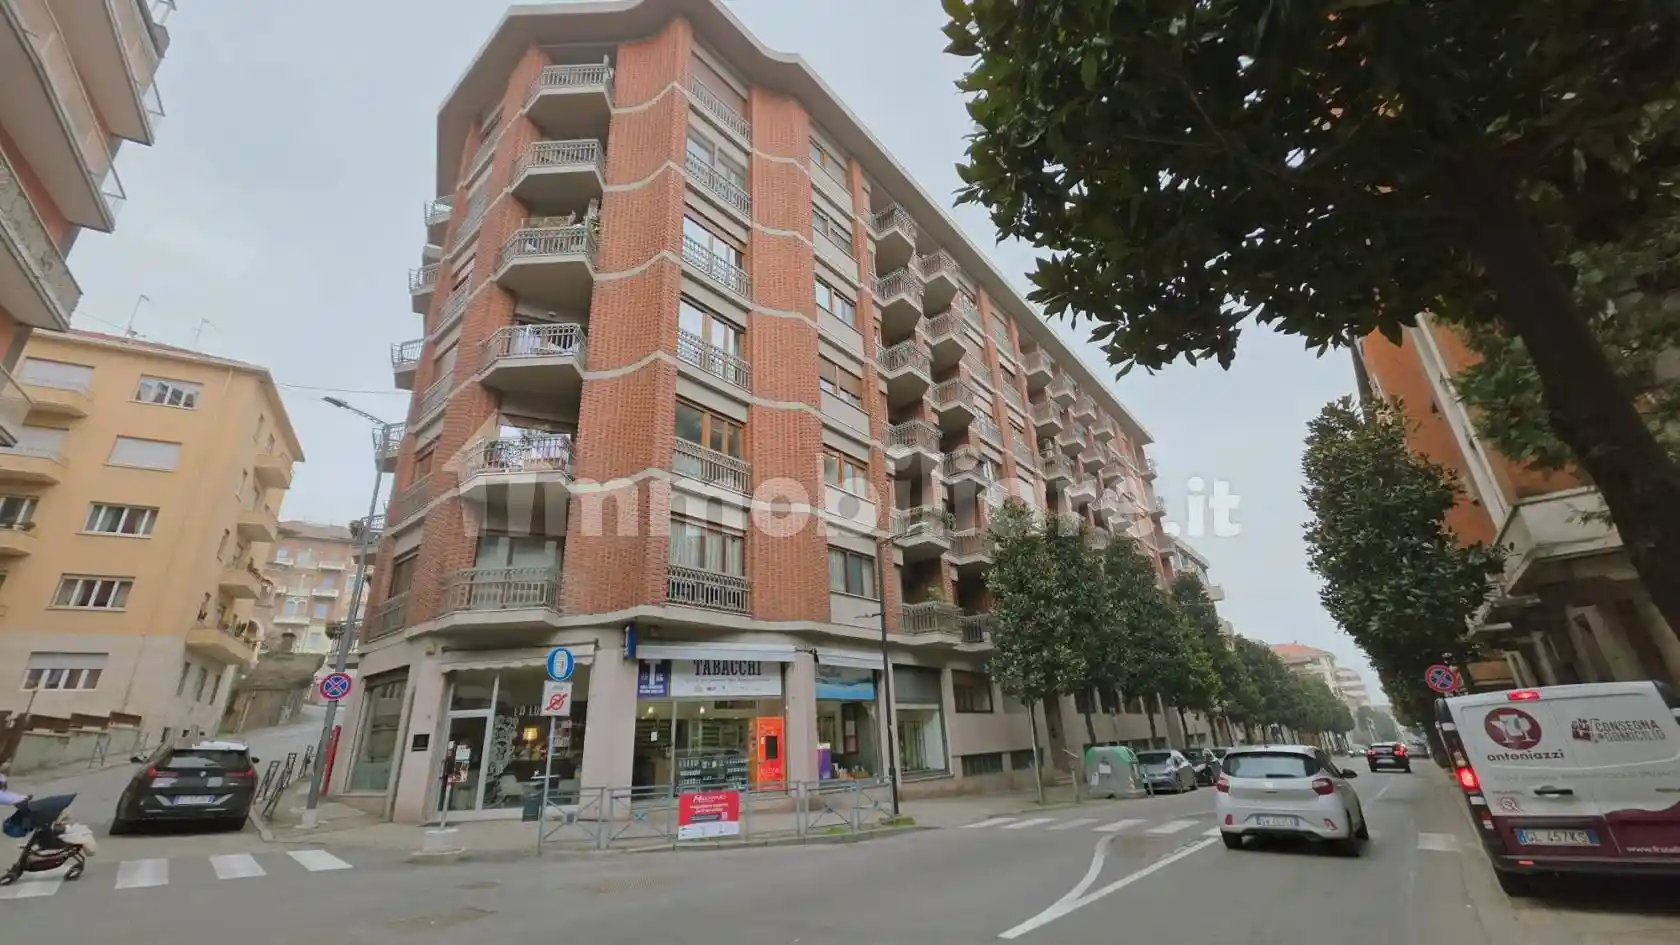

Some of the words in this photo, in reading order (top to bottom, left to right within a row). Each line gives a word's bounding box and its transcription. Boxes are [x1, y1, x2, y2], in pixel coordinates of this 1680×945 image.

[693, 660, 762, 676] TABACCHI
[1594, 719, 1660, 732] CONSEGNA
[1604, 728, 1666, 743] DOMICILIO
[1487, 749, 1565, 762] antoniazzi
